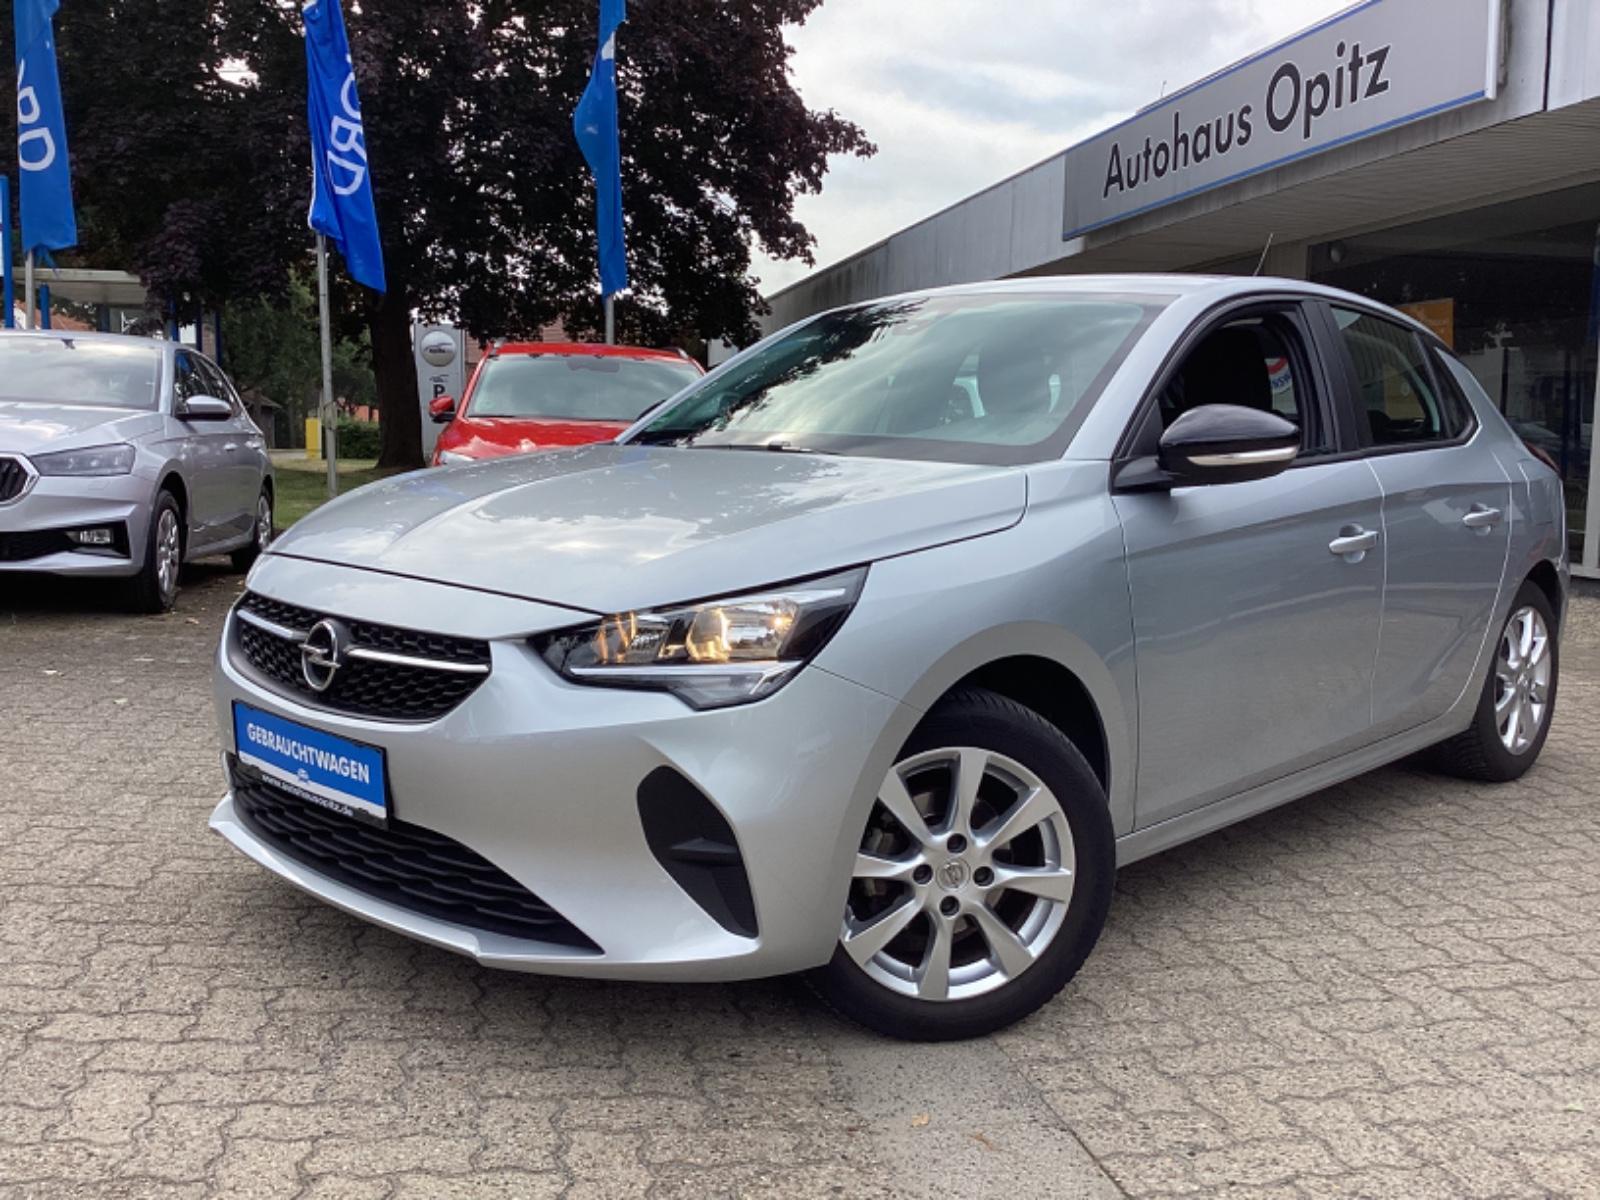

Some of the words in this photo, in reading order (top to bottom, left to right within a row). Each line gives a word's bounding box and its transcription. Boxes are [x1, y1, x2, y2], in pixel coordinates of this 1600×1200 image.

[1103, 105, 1252, 199] Autohaus
[1265, 41, 1391, 139] Opitz
[246, 722, 370, 784] GEBRAUCHTWAGEN
